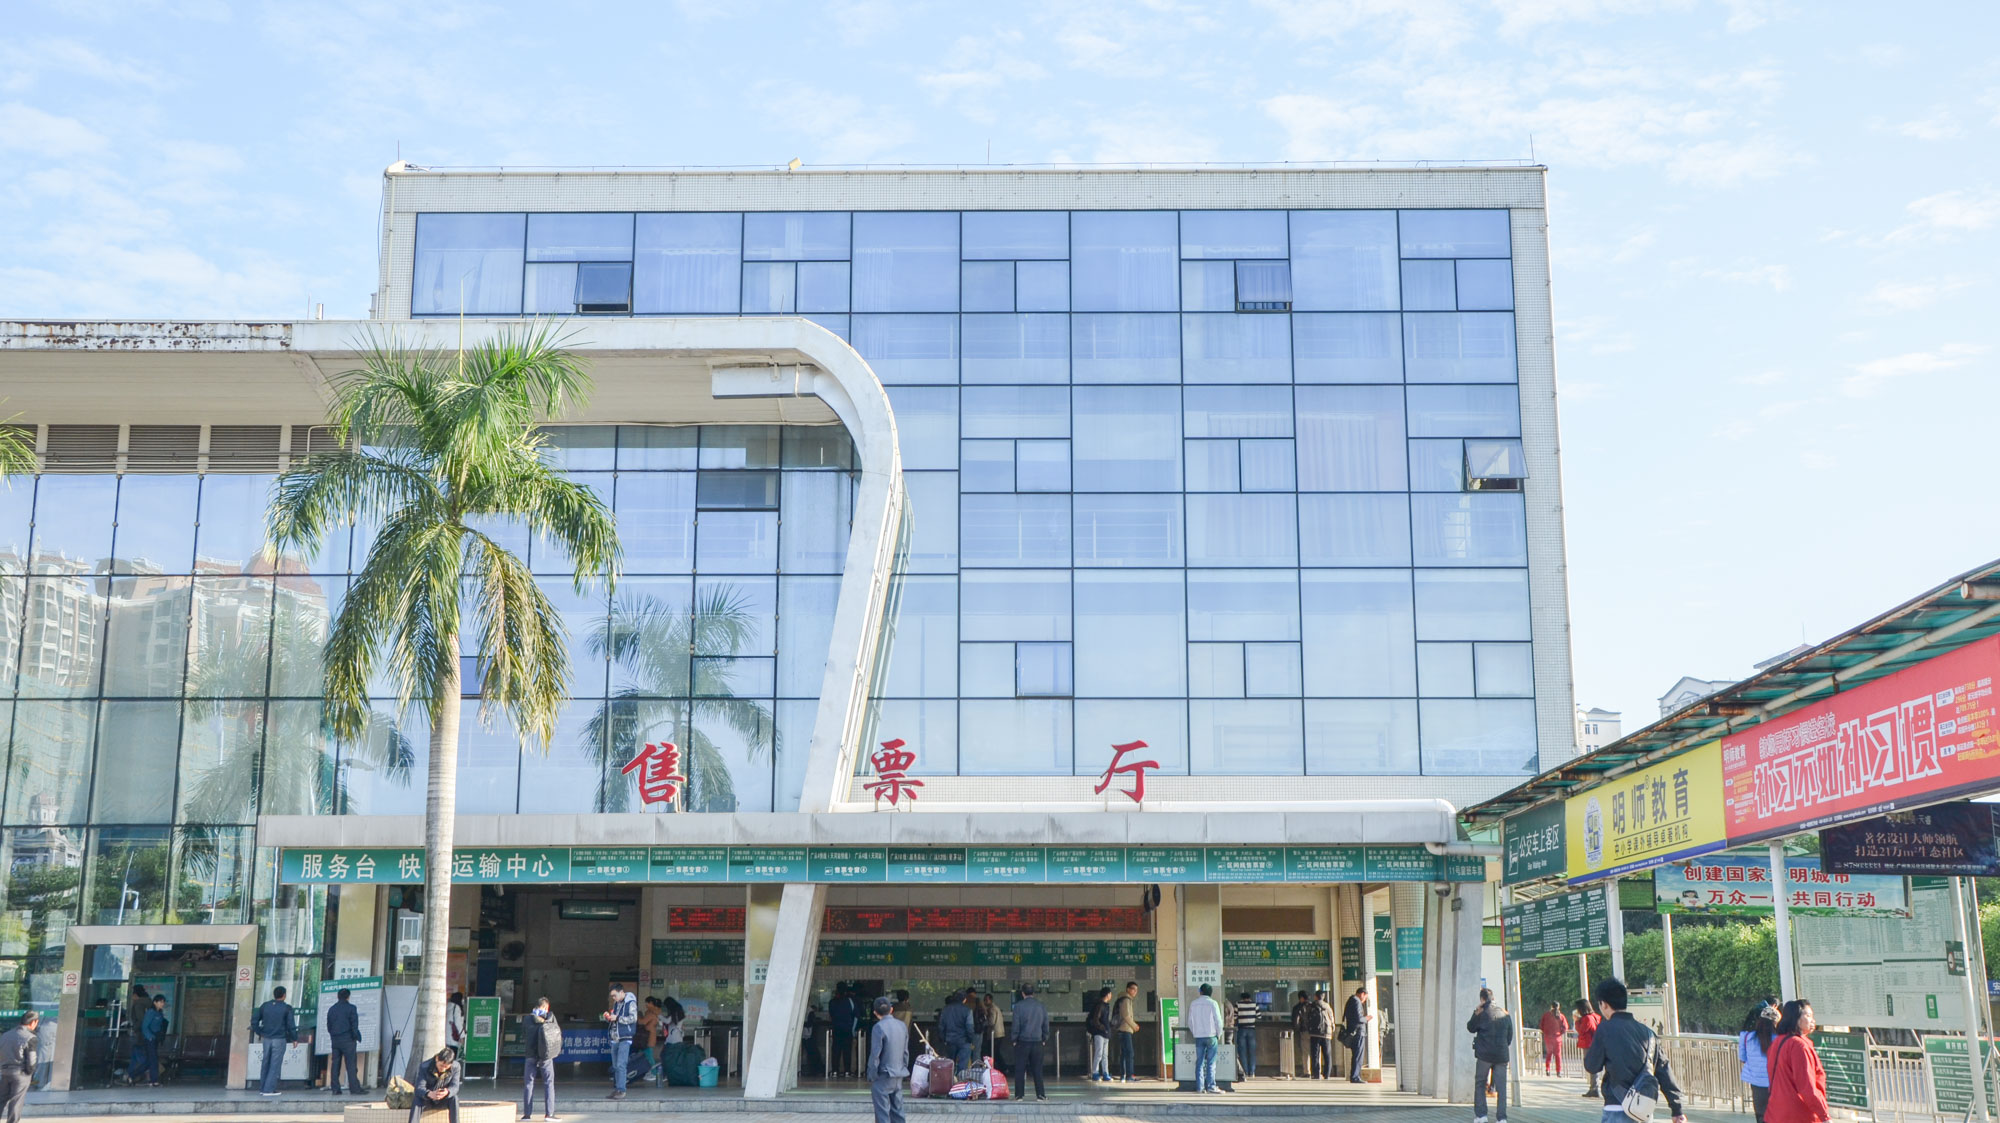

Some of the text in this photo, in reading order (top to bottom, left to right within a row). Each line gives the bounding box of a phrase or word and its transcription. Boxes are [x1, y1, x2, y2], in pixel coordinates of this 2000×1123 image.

[622, 739, 1160, 804] 售票厅
[1754, 695, 1943, 819] 补习不如补习惯
[1519, 824, 1560, 858] 公交车上客区
[301, 853, 554, 880] 服务台 快运输中心
[1683, 866, 1850, 884] 创建国家明城市
[1708, 890, 1876, 907] 万众一共同行动
